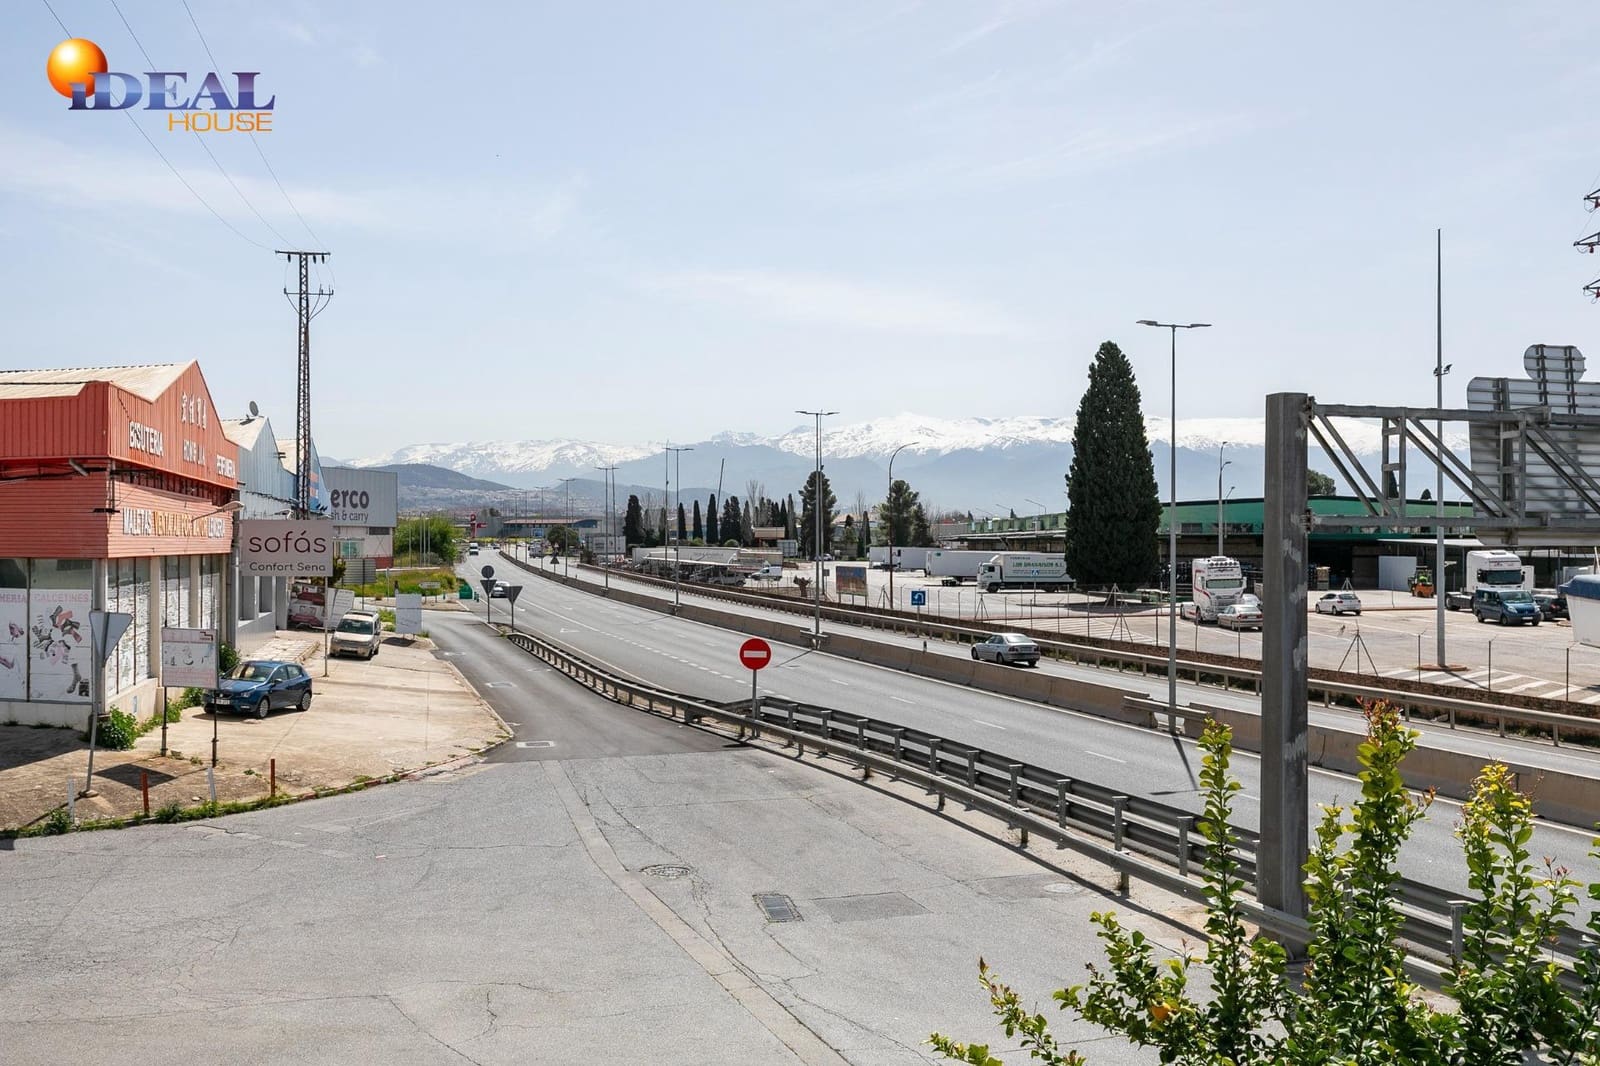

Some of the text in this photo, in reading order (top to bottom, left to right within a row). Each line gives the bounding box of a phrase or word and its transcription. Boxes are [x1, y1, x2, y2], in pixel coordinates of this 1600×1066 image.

[349, 511, 369, 524] carry
[249, 530, 327, 553] sofás
[250, 562, 326, 572] Confort Sena
